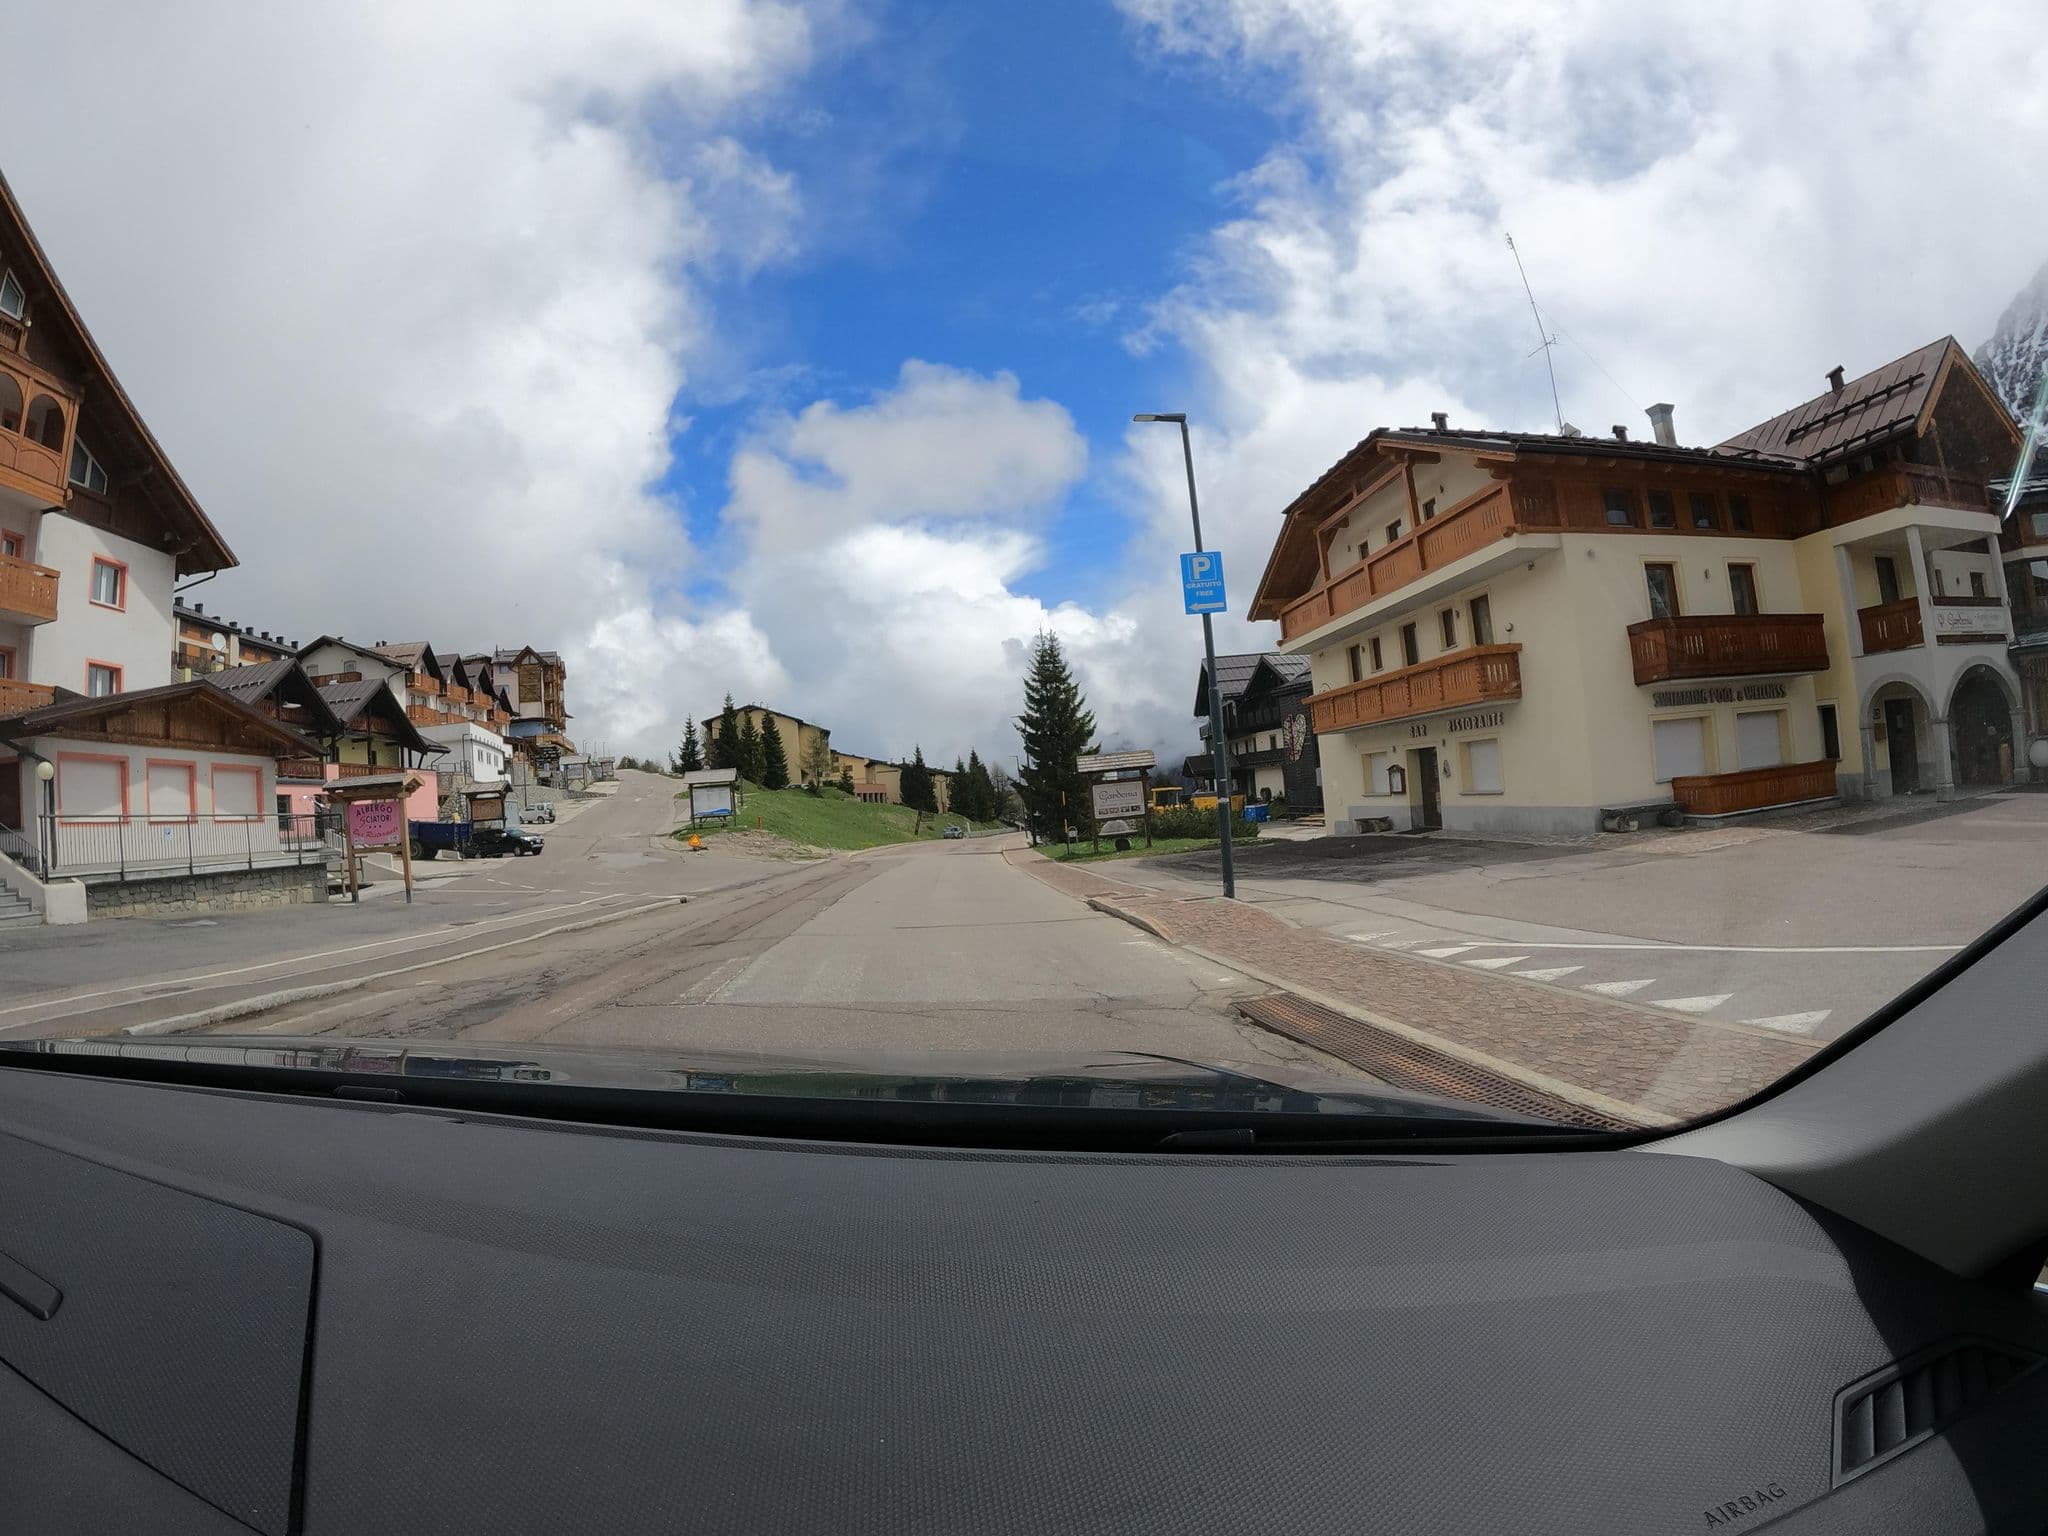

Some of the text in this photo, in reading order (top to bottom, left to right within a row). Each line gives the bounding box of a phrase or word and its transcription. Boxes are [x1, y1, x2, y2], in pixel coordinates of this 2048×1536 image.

[1192, 556, 1211, 580] P
[1186, 581, 1222, 589] GRATUITO
[1652, 690, 1708, 708] SWIMMING
[1709, 687, 1734, 704] POOL
[1743, 684, 1787, 701] WELLNESS
[1408, 711, 1505, 739] BAR RISTORANTE
[1098, 789, 1138, 803] Gardenia
[356, 804, 393, 817] ALBERGO
[359, 814, 392, 828] SCIATORI
[1703, 1481, 1788, 1530] AIRBAG
